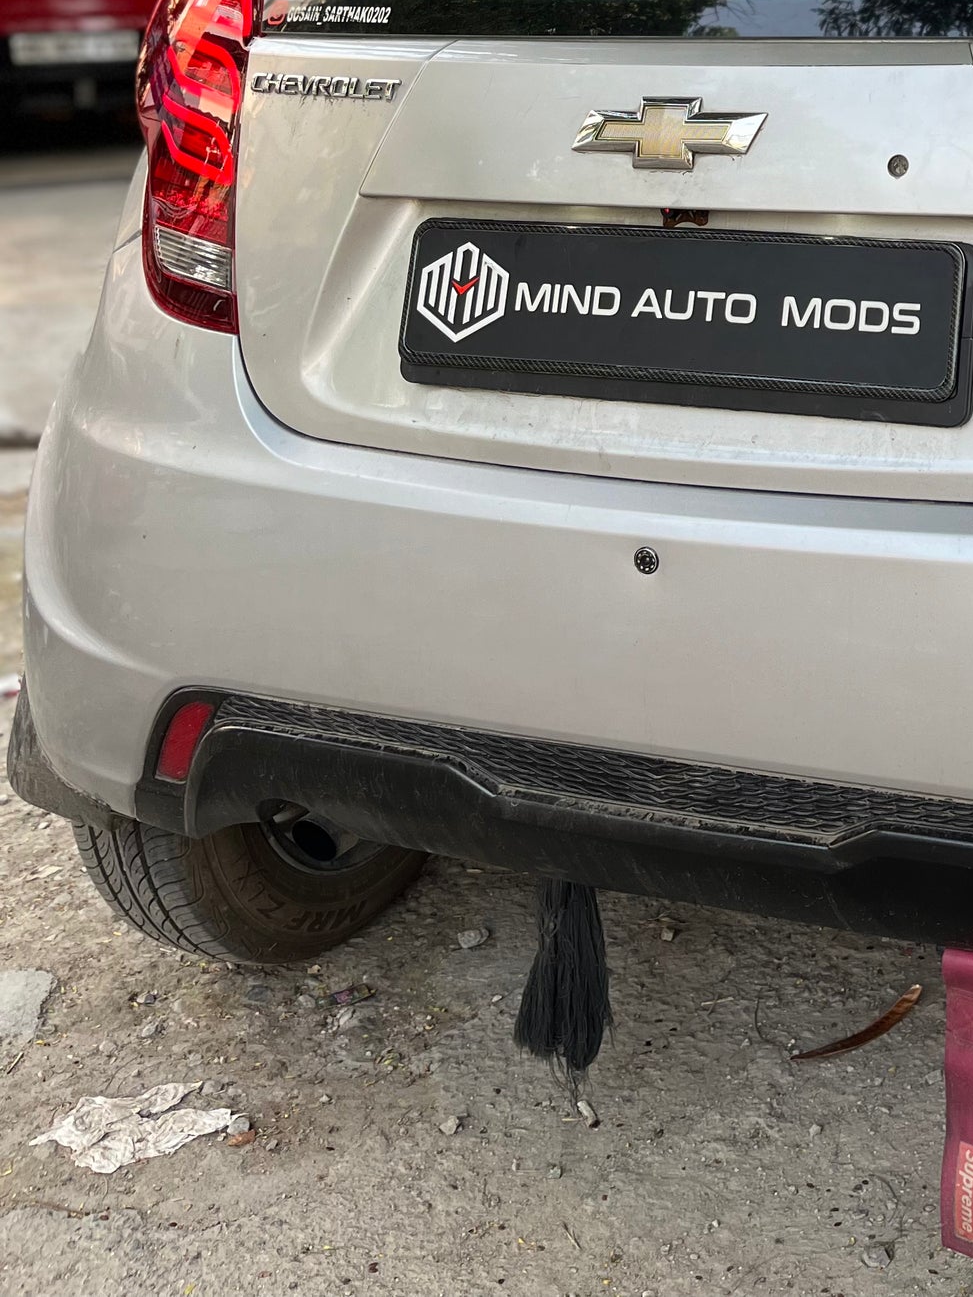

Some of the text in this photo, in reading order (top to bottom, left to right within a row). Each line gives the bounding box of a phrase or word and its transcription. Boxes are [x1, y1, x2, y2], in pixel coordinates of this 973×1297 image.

[251, 72, 402, 101] CHEVROLET
[514, 282, 921, 335] MIND AUTO MODS
